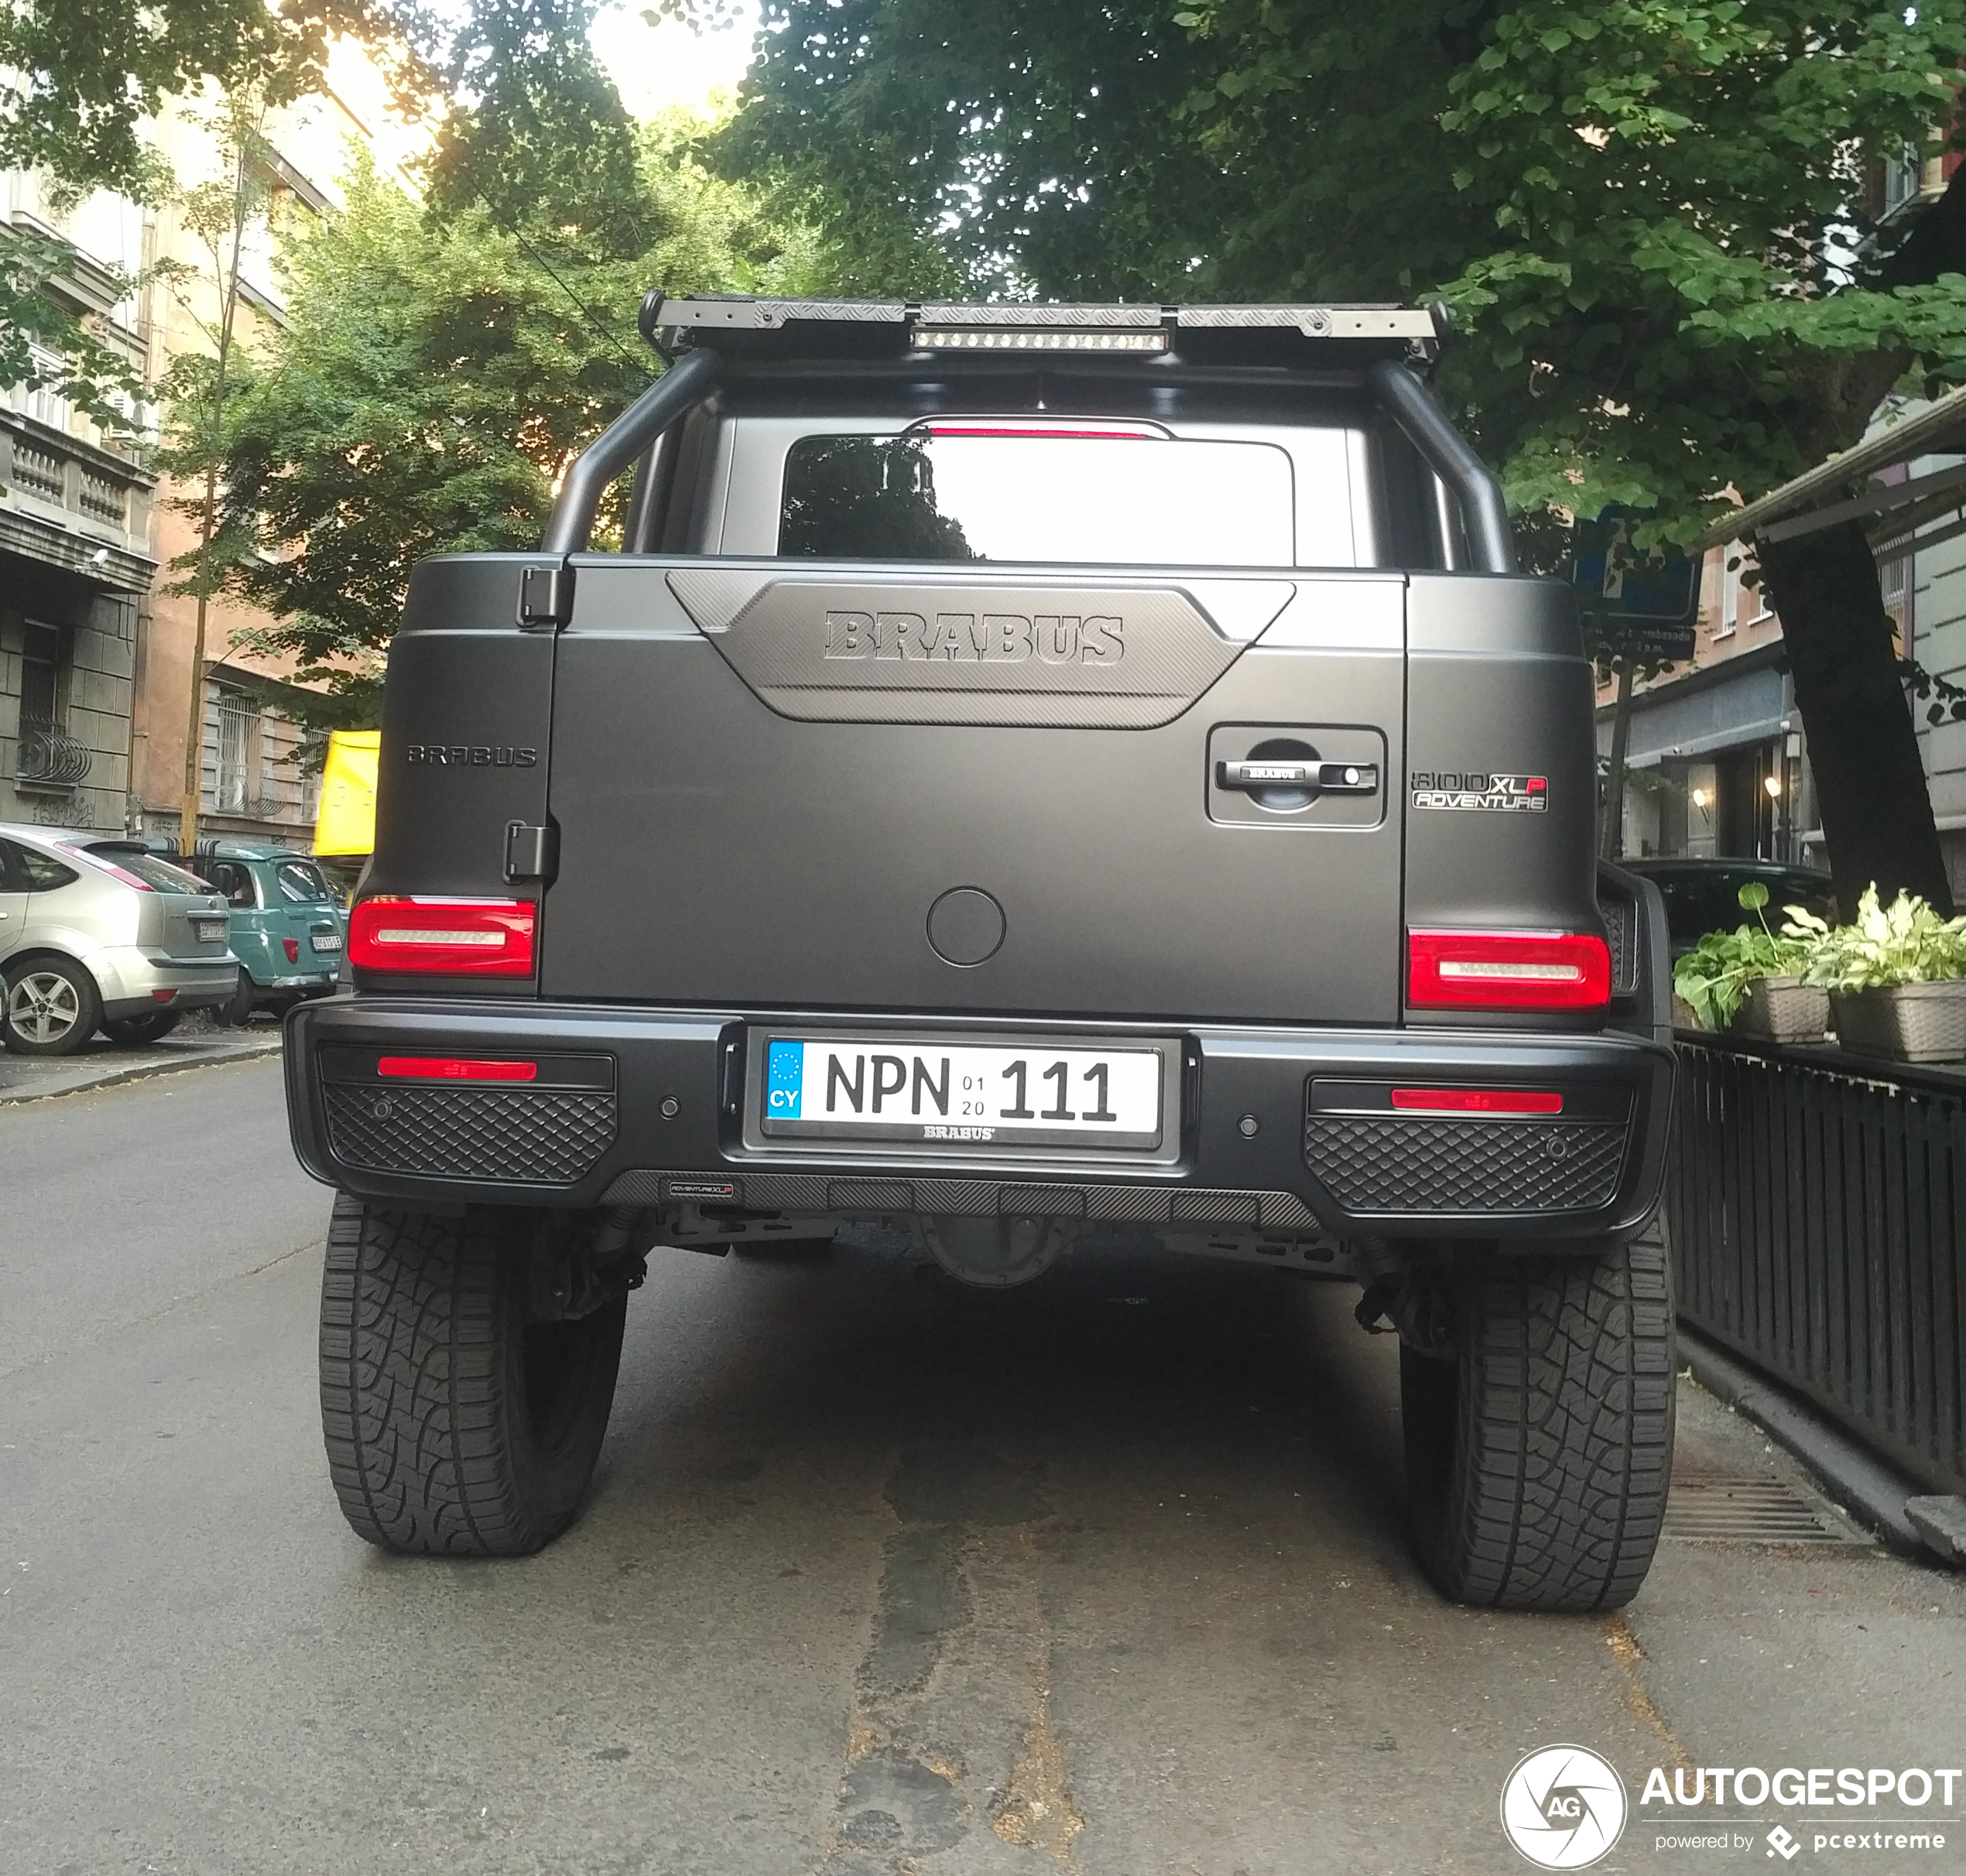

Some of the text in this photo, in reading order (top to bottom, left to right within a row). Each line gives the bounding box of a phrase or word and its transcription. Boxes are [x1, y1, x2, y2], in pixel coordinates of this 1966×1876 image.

[824, 611, 1125, 666] BRABUS
[406, 745, 538, 768] BRABUS
[1416, 793, 1546, 810] ADVENTURE
[825, 1053, 1118, 1122] NPN 111
[962, 1076, 985, 1091] 01
[769, 1090, 800, 1108] CY
[962, 1101, 985, 1116] 20
